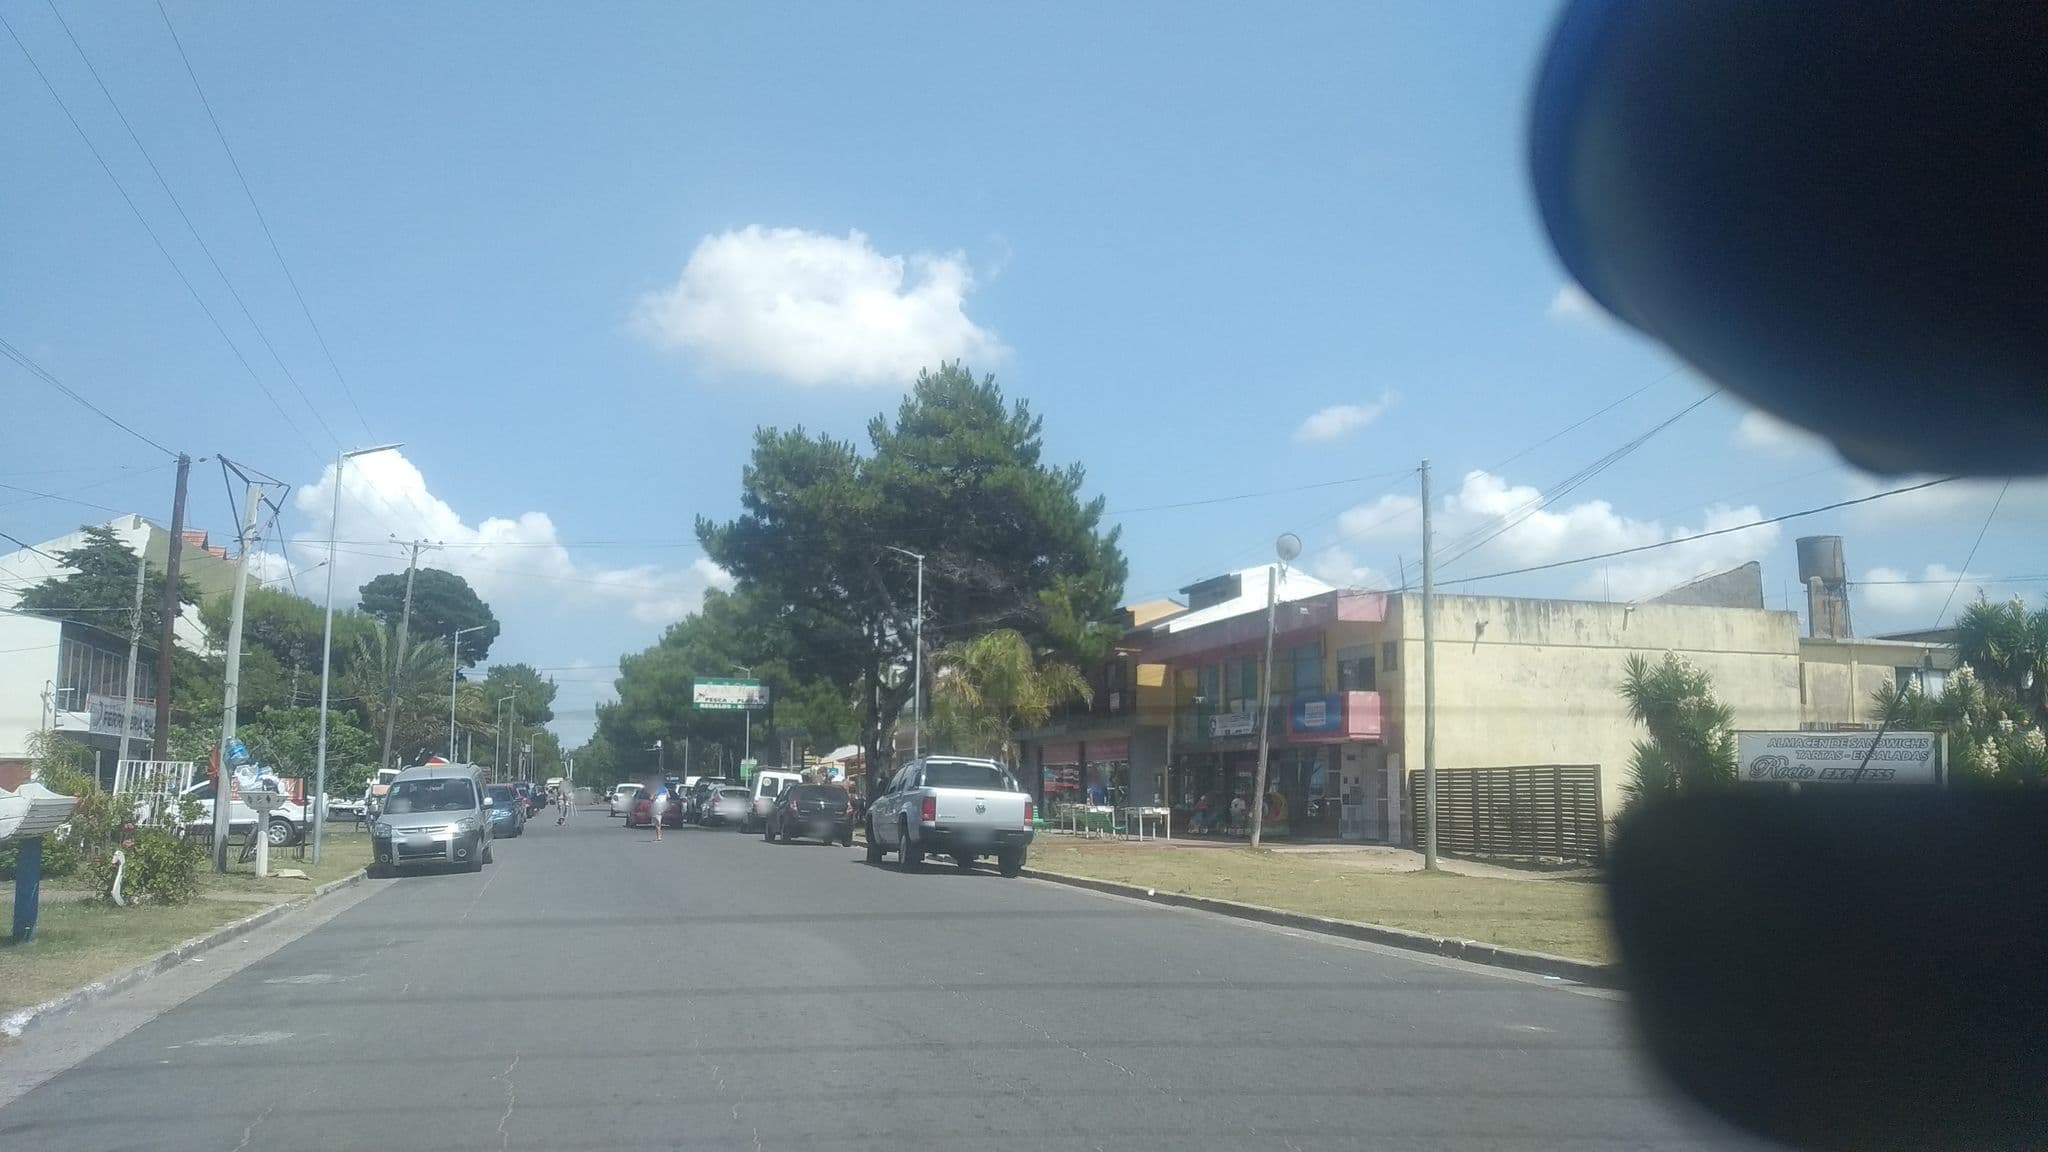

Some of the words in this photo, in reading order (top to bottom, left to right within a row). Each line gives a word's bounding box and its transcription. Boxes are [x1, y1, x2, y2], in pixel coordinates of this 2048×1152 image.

[1767, 737, 1828, 749] ALMACEN
[1829, 737, 1849, 749] DE
[1849, 737, 1930, 749] SANDWICHS
[1796, 749, 1844, 761] TARTAS
[1851, 750, 1930, 761] ENSALADAS
